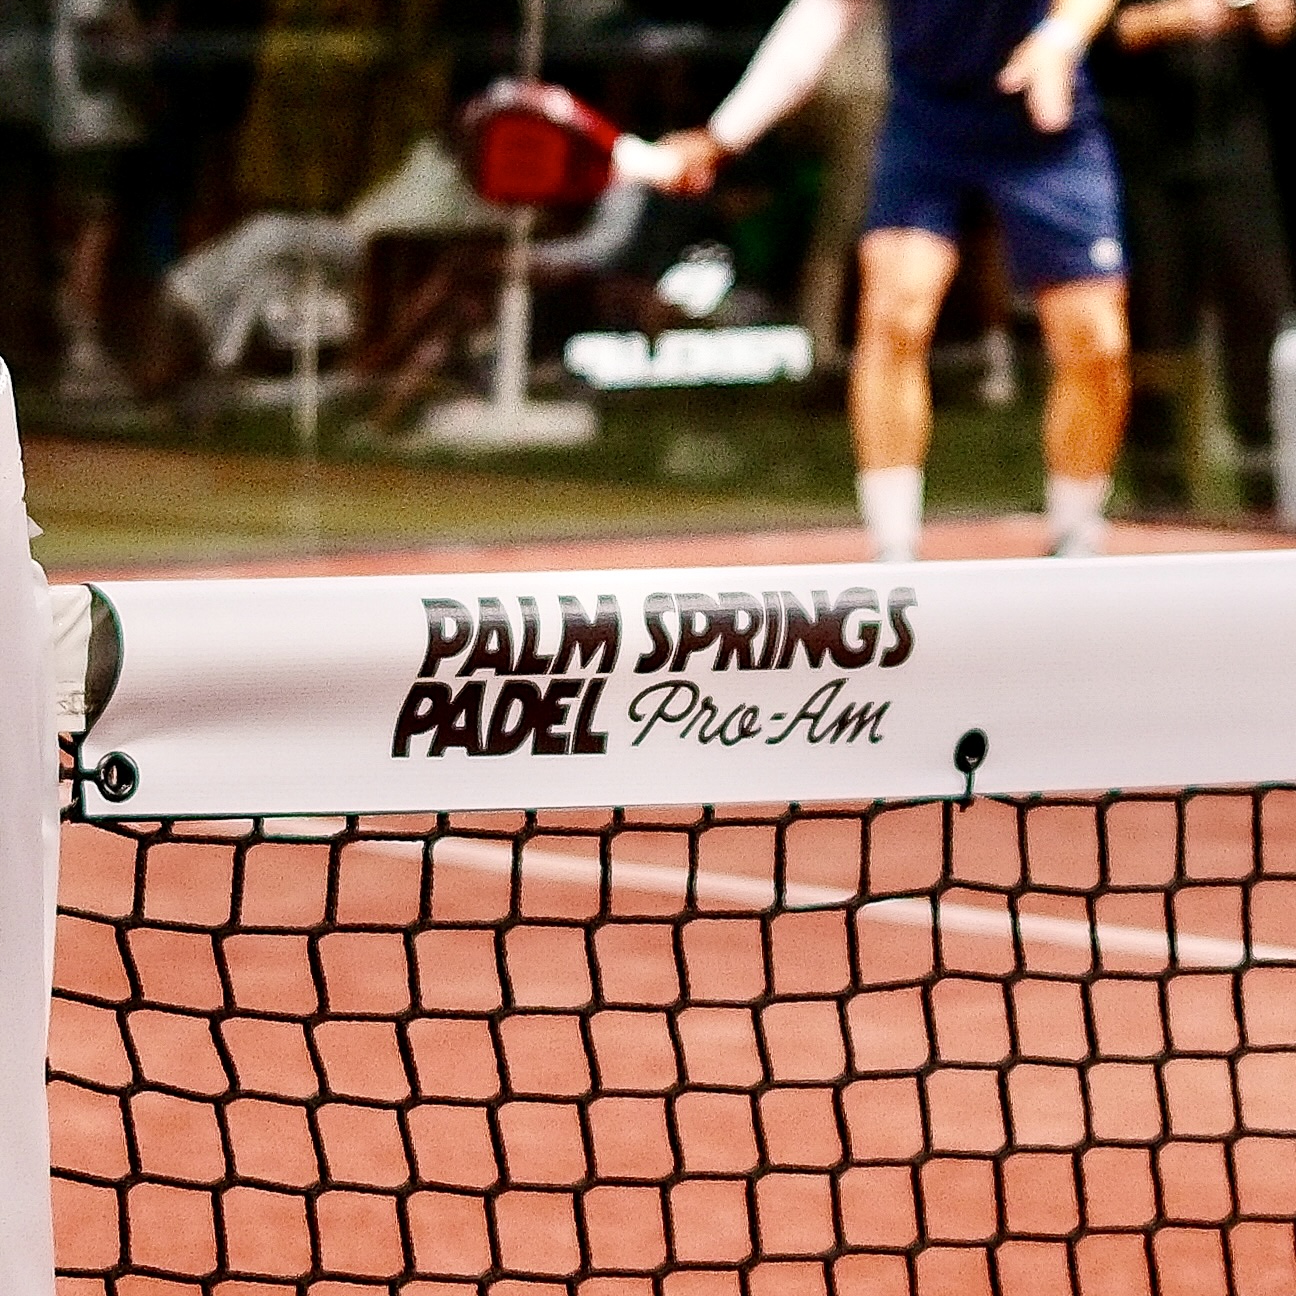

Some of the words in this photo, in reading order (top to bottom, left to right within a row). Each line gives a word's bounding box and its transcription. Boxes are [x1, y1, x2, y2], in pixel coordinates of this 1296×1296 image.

[417, 594, 623, 677] PALM
[632, 586, 918, 674] SPRINGS
[390, 676, 609, 758] PADEL
[627, 676, 893, 748] Pro-Am
